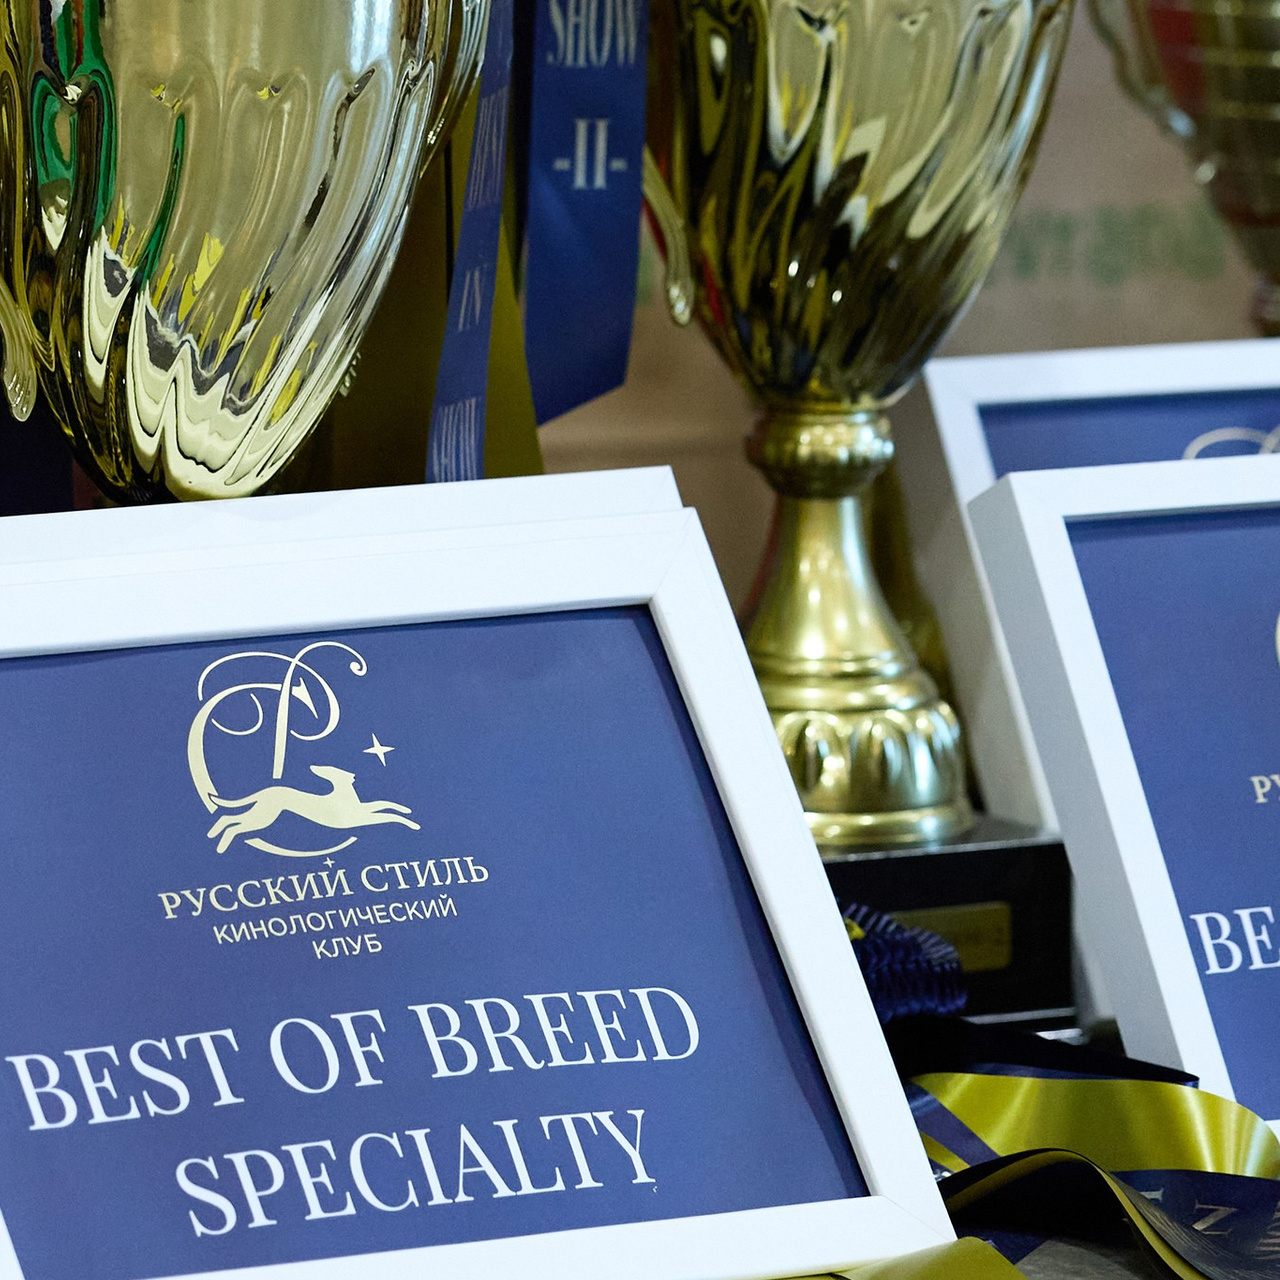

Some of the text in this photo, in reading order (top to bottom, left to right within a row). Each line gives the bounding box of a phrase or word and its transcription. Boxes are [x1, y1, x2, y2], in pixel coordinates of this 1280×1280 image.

[158, 856, 489, 919] РУССКИЙ СТИЛЬ
[213, 894, 458, 944] КИНОЛОГИЧЕСКИЙ
[312, 933, 382, 959] КЛУБ
[6, 986, 701, 1131] BEST OF BREED
[174, 1109, 657, 1239] SPECIALTY
